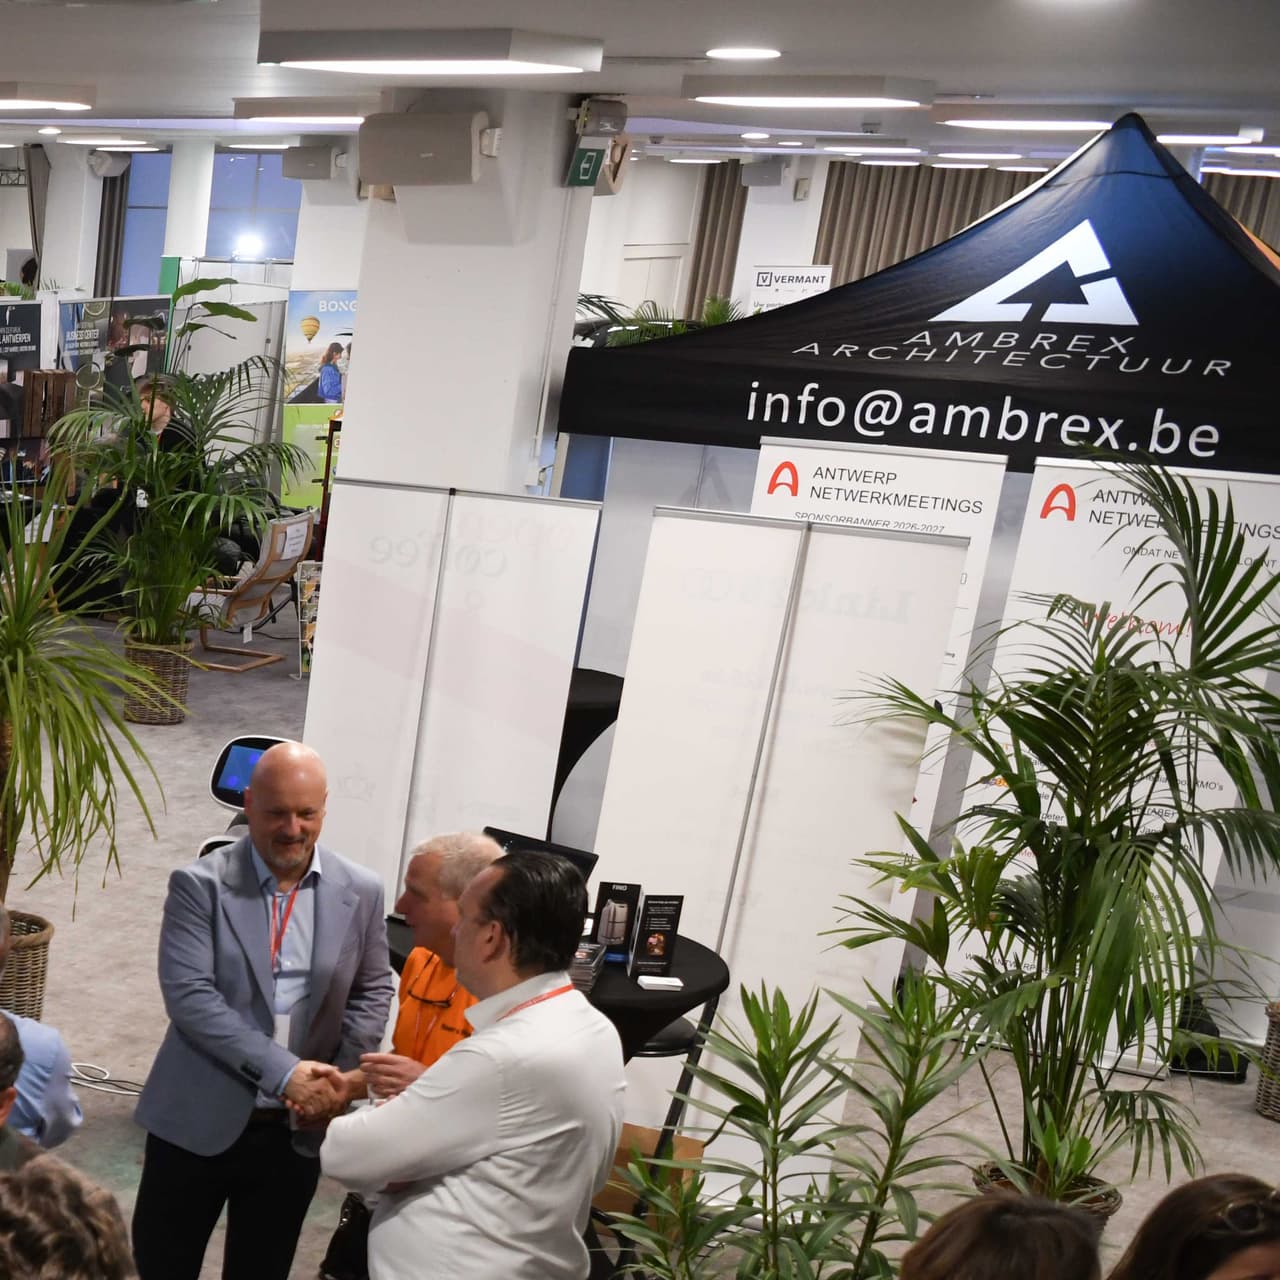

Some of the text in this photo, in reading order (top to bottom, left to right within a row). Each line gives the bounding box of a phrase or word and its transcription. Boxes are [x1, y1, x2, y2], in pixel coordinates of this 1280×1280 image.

[774, 275, 826, 284] VERMANT
[903, 330, 1135, 354] AMBREX
[792, 341, 1233, 377] ARCHITECTUUR
[747, 381, 1220, 458] info@ambrex.be
[813, 466, 897, 485] ANTWERP
[809, 486, 984, 514] NETWERKMEETINGS
[794, 511, 891, 529] SPONSORBANNER
